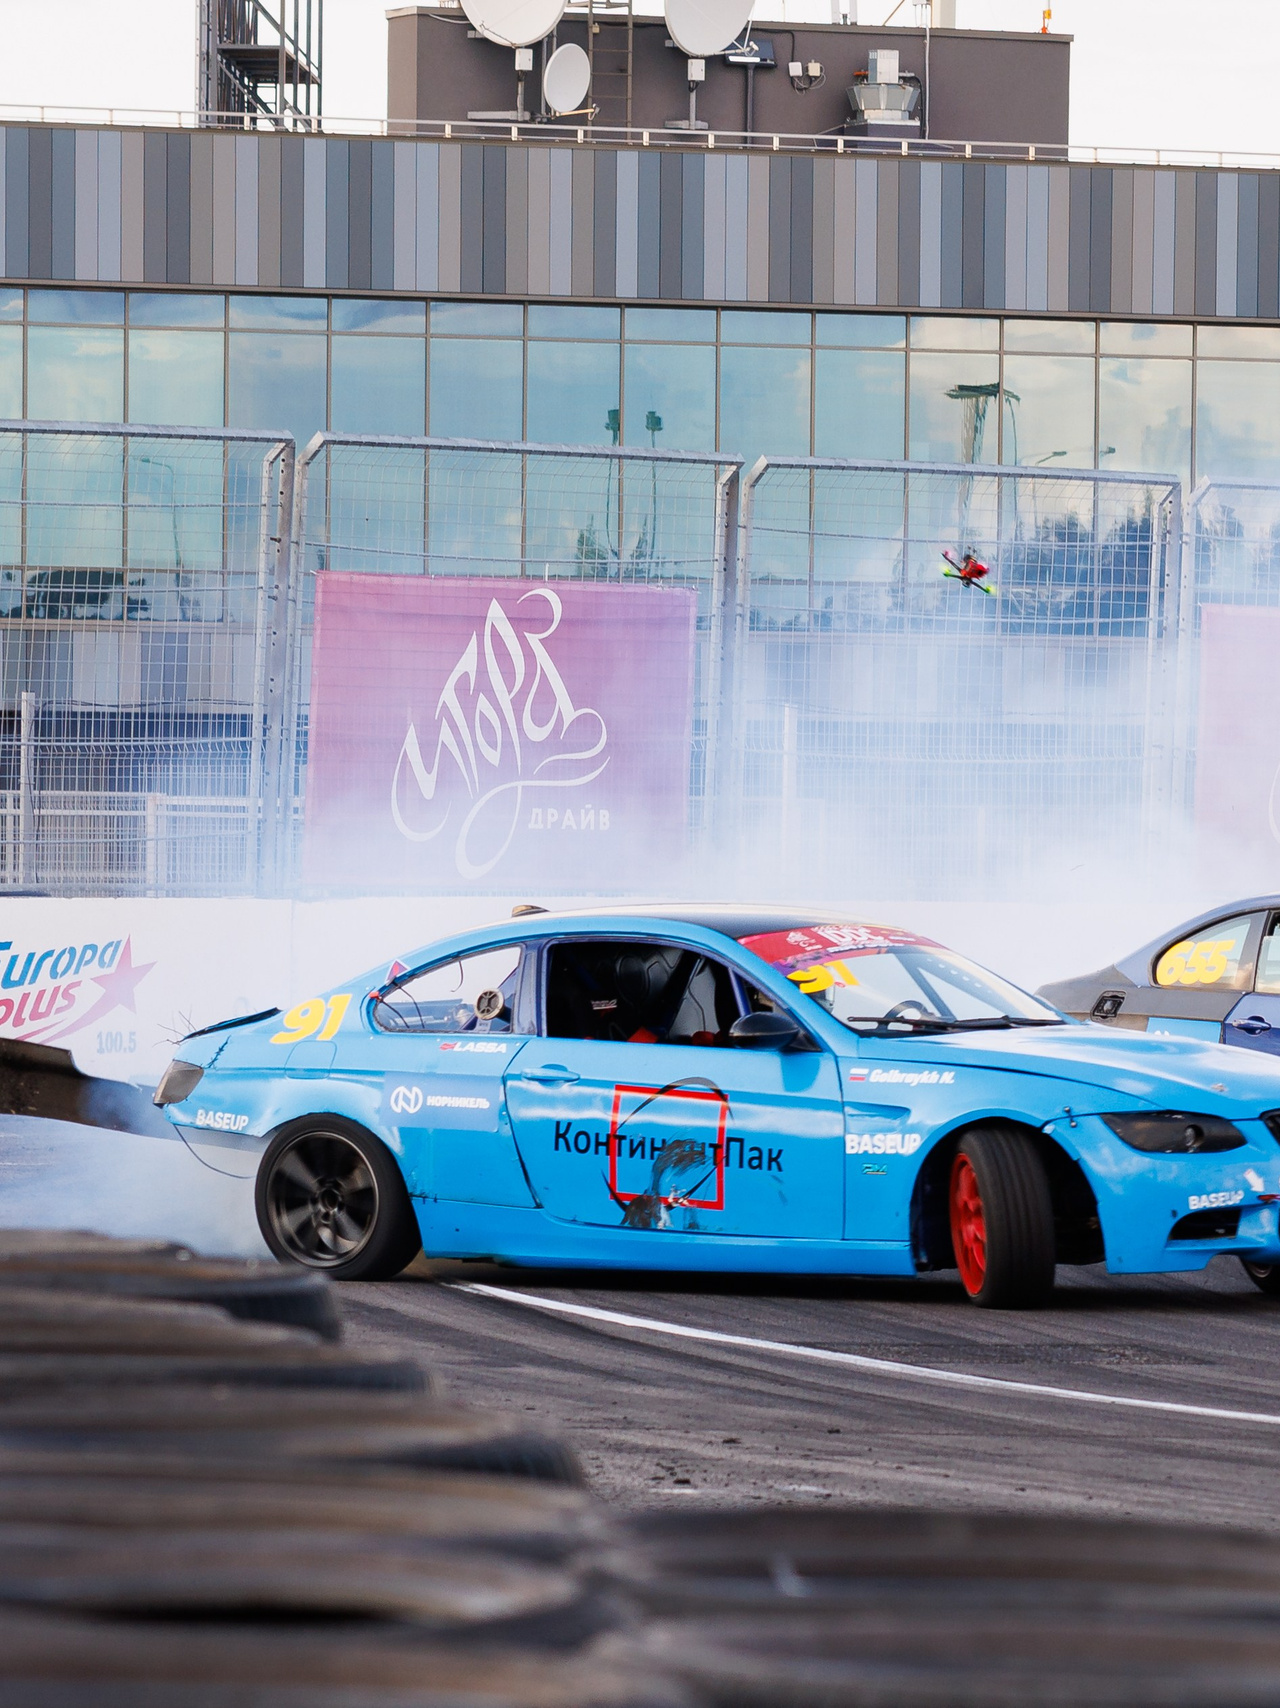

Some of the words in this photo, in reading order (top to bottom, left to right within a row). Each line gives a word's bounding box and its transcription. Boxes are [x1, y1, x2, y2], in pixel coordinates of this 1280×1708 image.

[528, 804, 610, 830] ДРАЙВ
[0, 940, 122, 990] uropa
[1156, 939, 1236, 986] 655
[269, 994, 352, 1044] 91
[96, 1030, 137, 1054] 100.5
[453, 1042, 507, 1054] LASSA
[426, 1095, 490, 1109] НОРНИКЕЛЬ
[195, 1109, 249, 1131] BASEUP
[554, 1120, 784, 1172] КонтиннтПак
[845, 1133, 921, 1156] BASEUP
[1188, 1190, 1245, 1210] BASEUP
